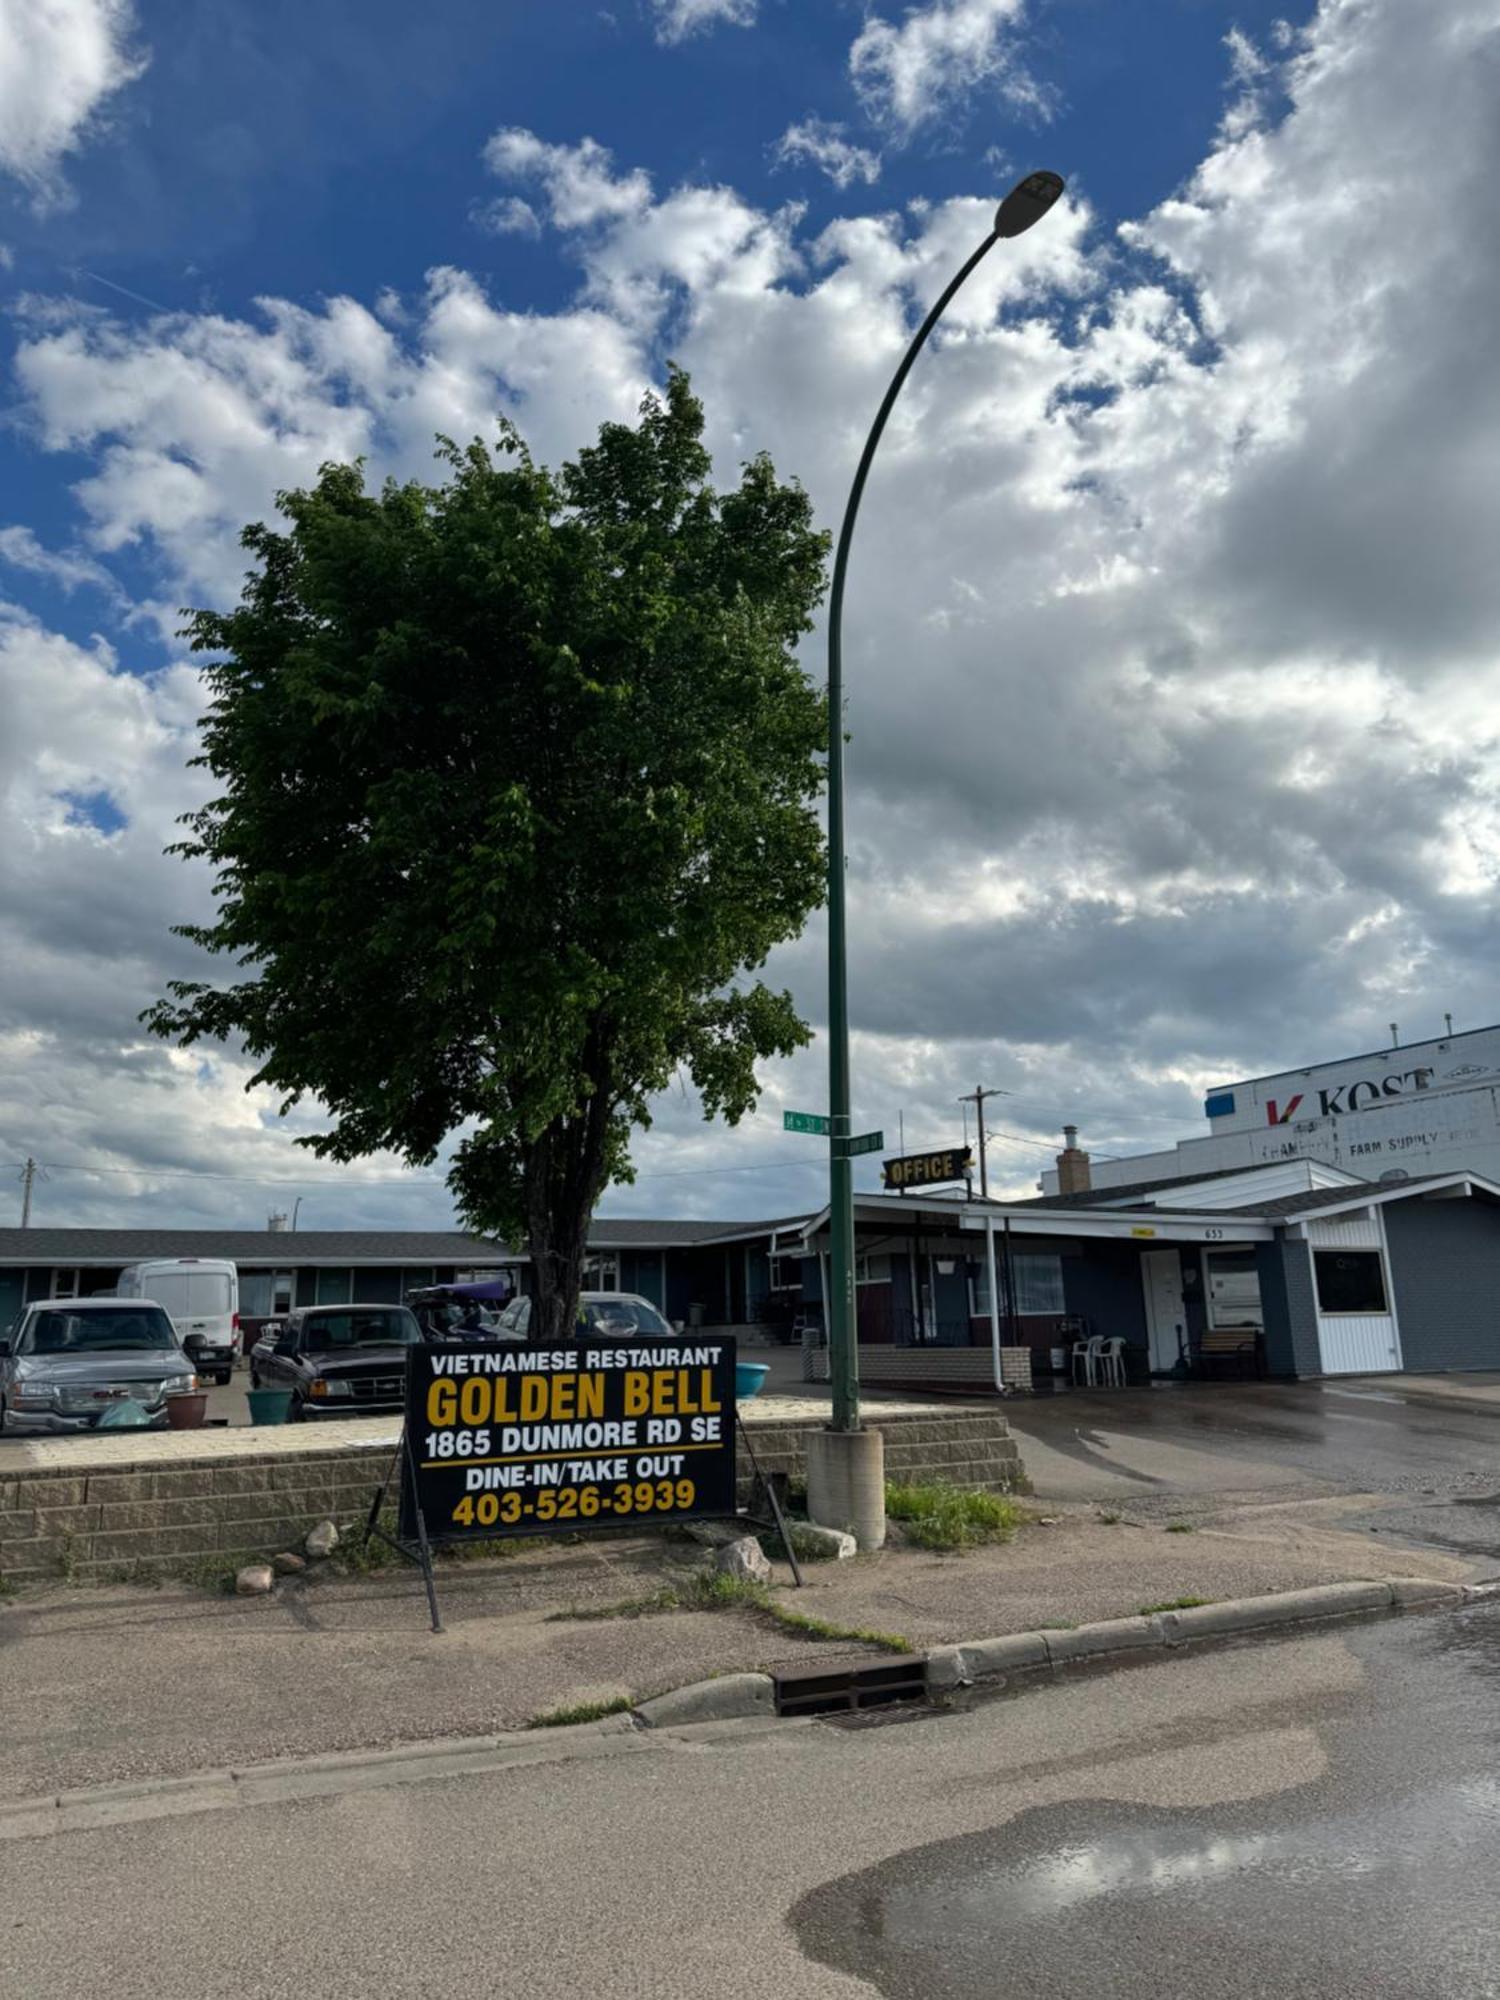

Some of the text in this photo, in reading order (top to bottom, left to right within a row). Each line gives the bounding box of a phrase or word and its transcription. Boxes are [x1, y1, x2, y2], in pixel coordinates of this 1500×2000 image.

[1350, 1140, 1382, 1157] FARM
[891, 1153, 954, 1185] OFFICE
[430, 1347, 722, 1375] VIETNAMESE RESTAURANT
[427, 1369, 722, 1427] GOLDEN BELL
[425, 1416, 722, 1458] 1865 DUNMORE RD SE
[465, 1455, 685, 1491] DINE-IN/TAKE OUT
[452, 1479, 696, 1526] 403-526-3939
